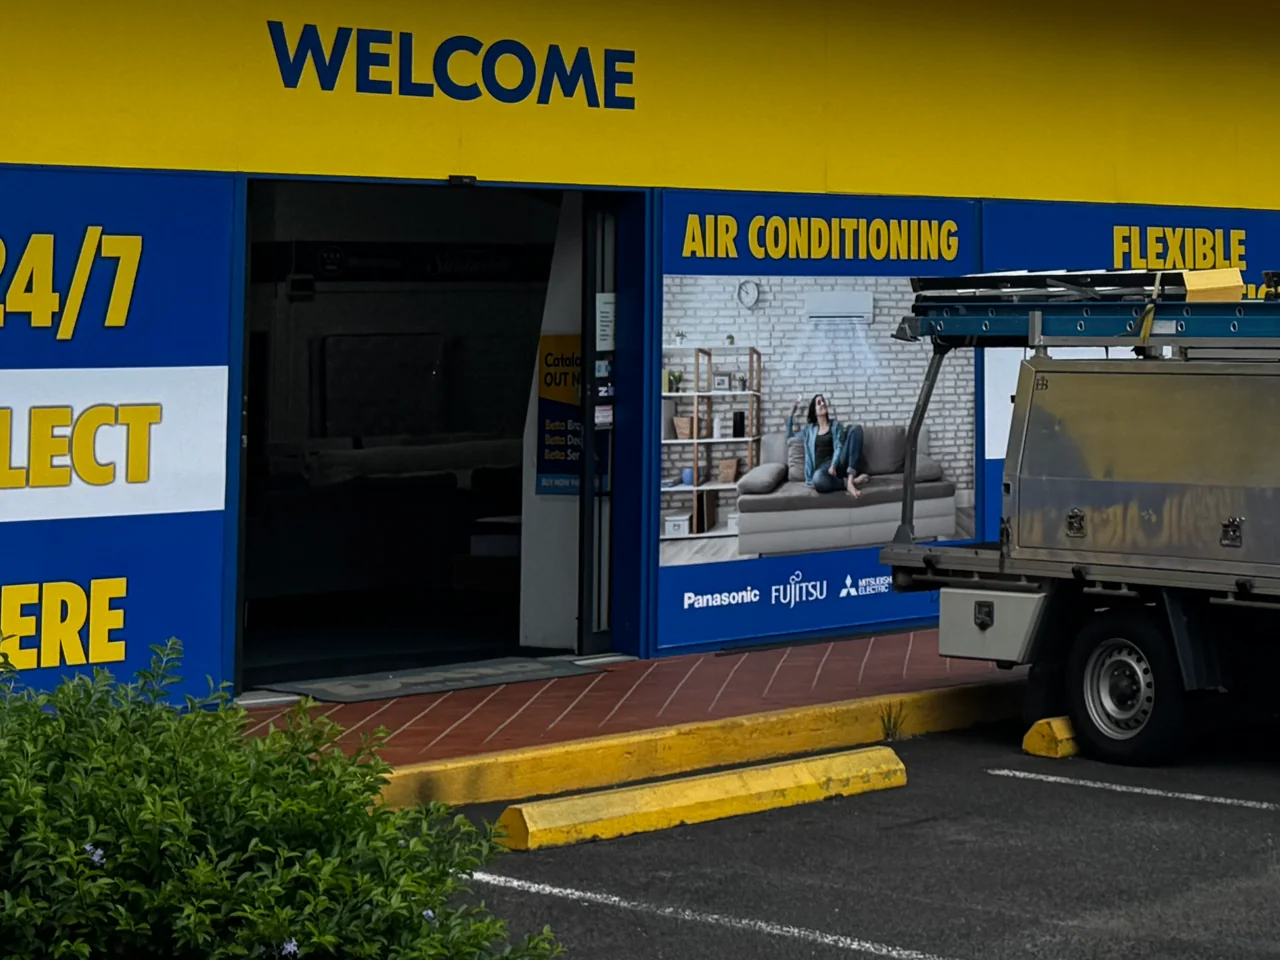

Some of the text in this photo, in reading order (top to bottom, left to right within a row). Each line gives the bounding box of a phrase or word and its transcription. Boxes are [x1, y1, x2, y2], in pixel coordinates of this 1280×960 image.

[267, 20, 636, 110] WELCOME
[681, 213, 960, 261] AIR CONDITIONING
[1113, 225, 1247, 270] FLEXIBLE
[0, 225, 143, 340] 4/7
[544, 371, 569, 388] OUT
[683, 572, 827, 609] Panasonic FUJITSU
[0, 576, 127, 671] ERE
